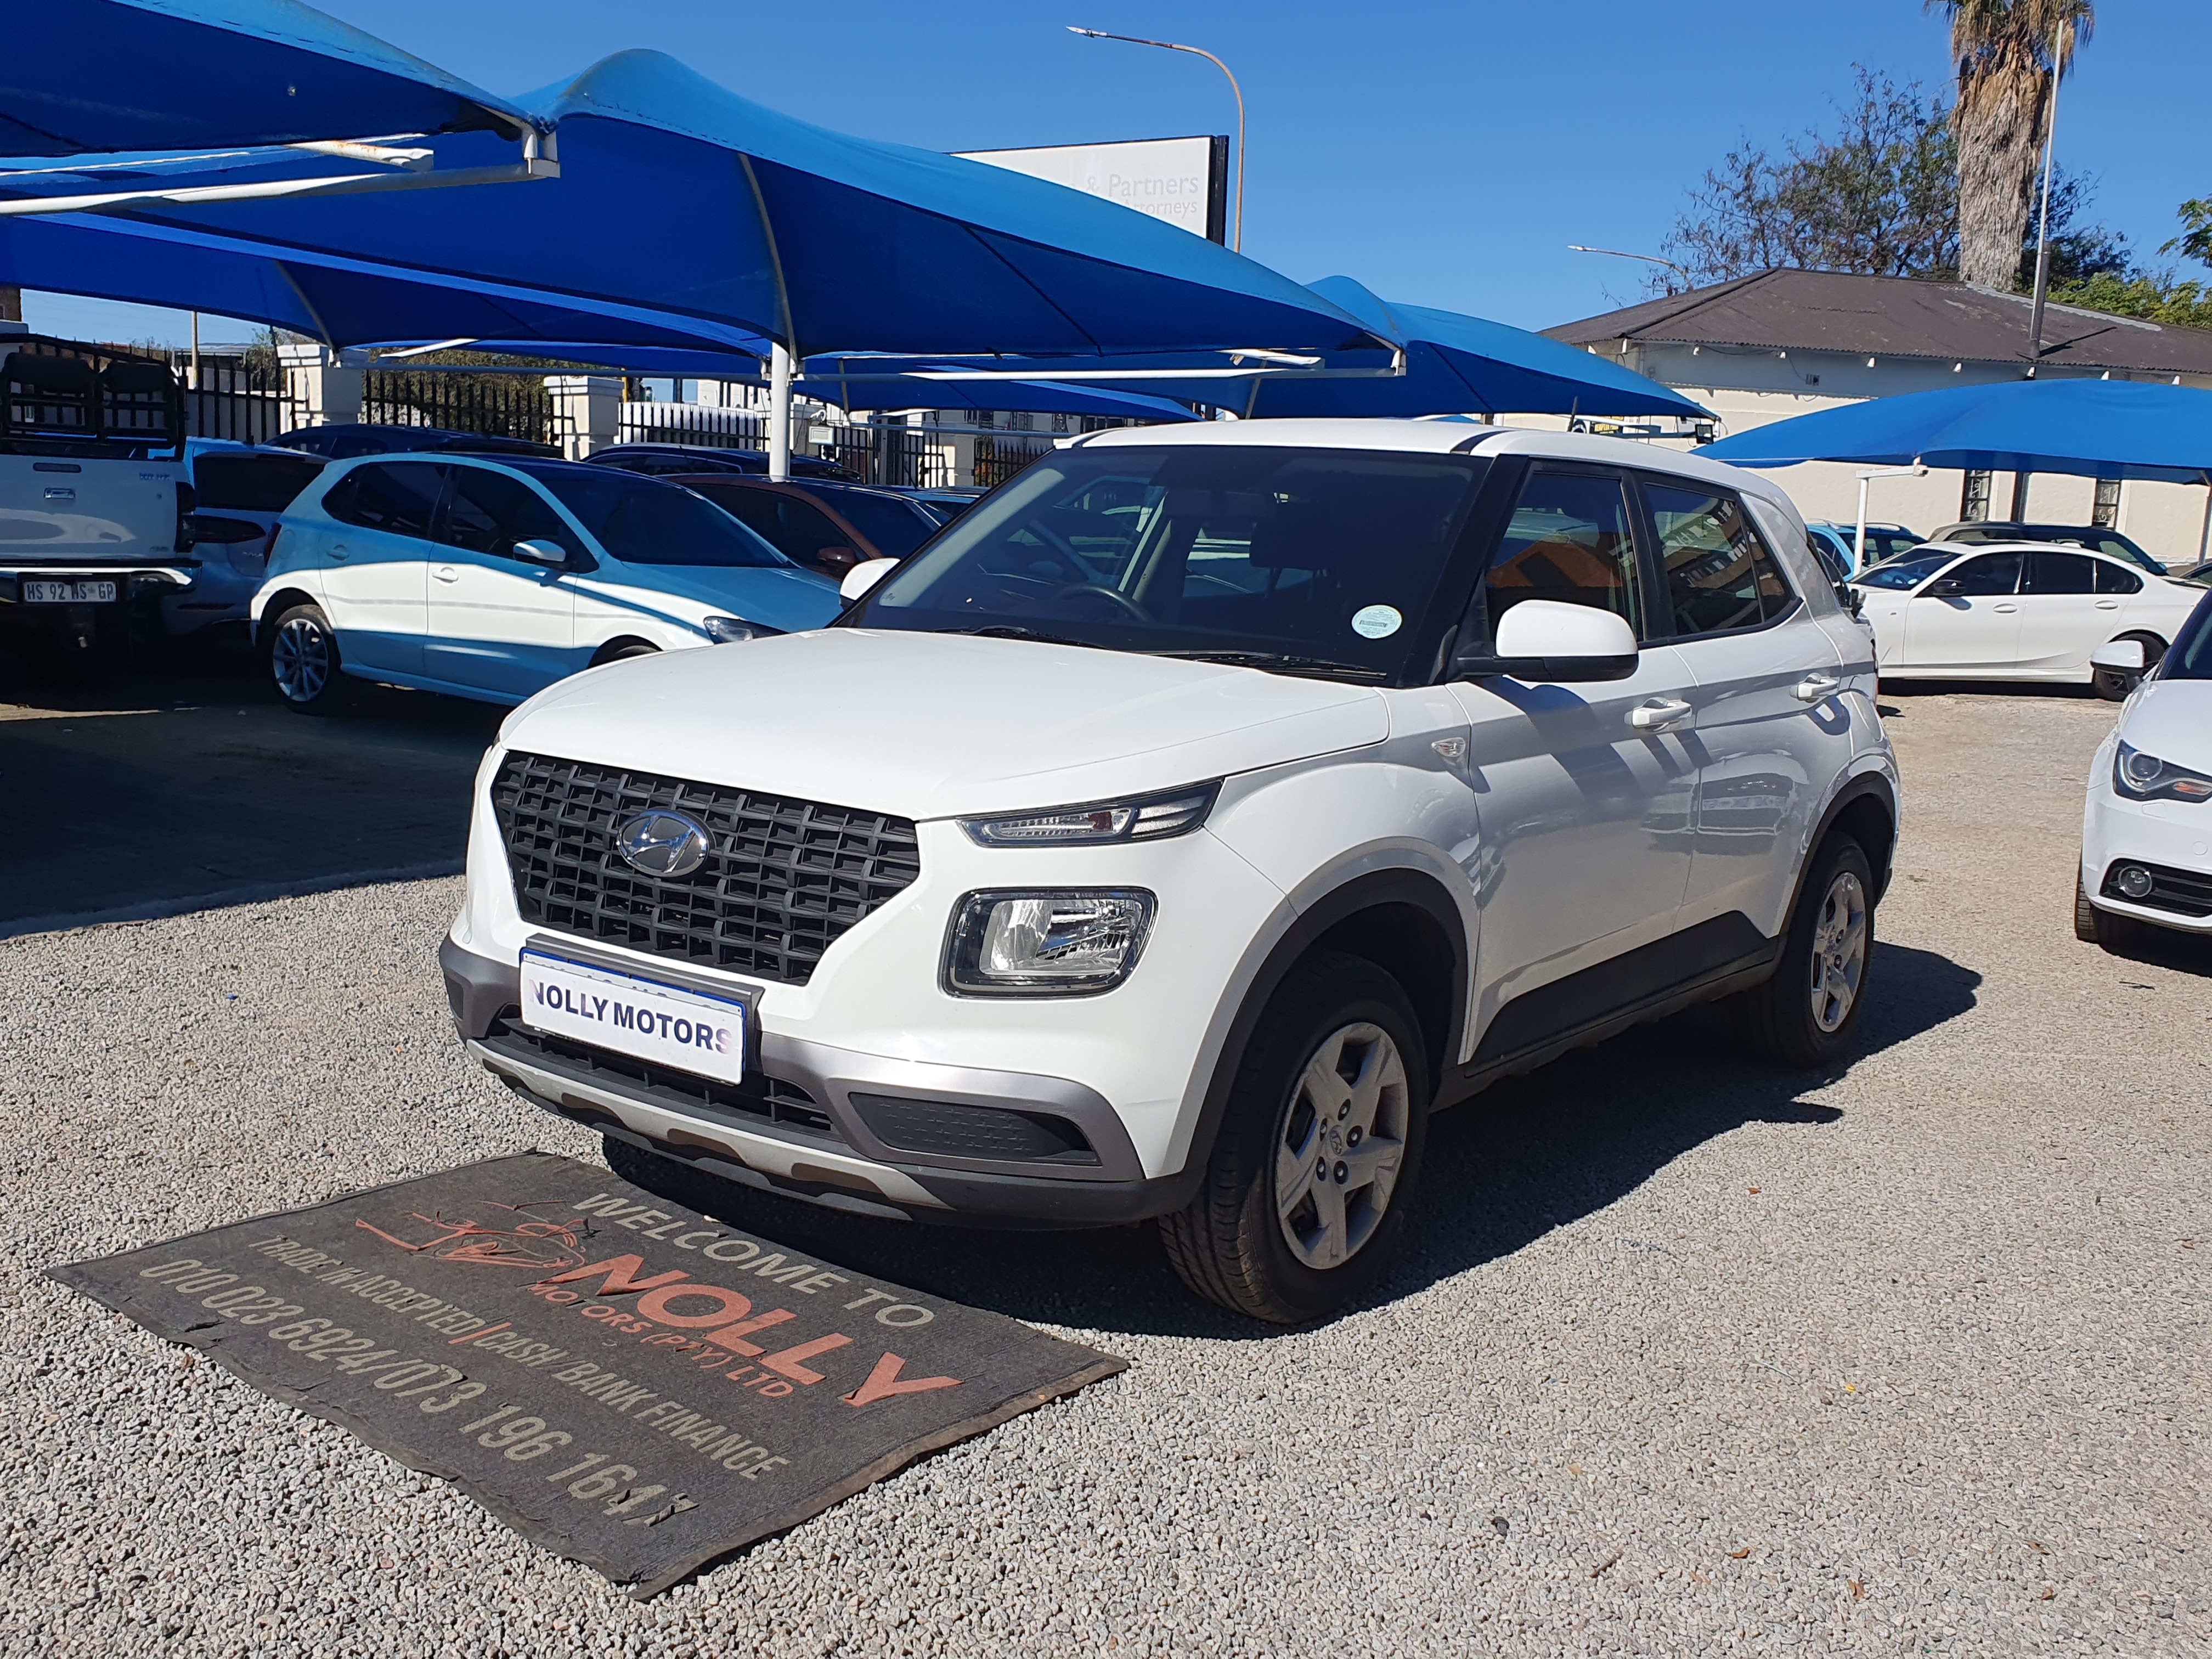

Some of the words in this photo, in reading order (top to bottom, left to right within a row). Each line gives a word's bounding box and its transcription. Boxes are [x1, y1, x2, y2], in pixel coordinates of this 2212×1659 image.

[1109, 174, 1199, 197] Partners
[27, 583, 43, 600] HS
[49, 583, 65, 600] 92
[98, 583, 113, 599] GP
[529, 979, 609, 1022] NOLLY
[614, 1002, 732, 1054] MOTORS
[572, 1193, 850, 1295] WELCOME
[843, 1287, 935, 1327] TO
[139, 1259, 240, 1294] 010
[201, 1285, 305, 1325] 023
[459, 1402, 574, 1461] 196
[248, 1237, 343, 1274] TRADE
[634, 1401, 791, 1481] FINANCE
[537, 1253, 966, 1407] NOLLY
[725, 1365, 794, 1397] LTD
